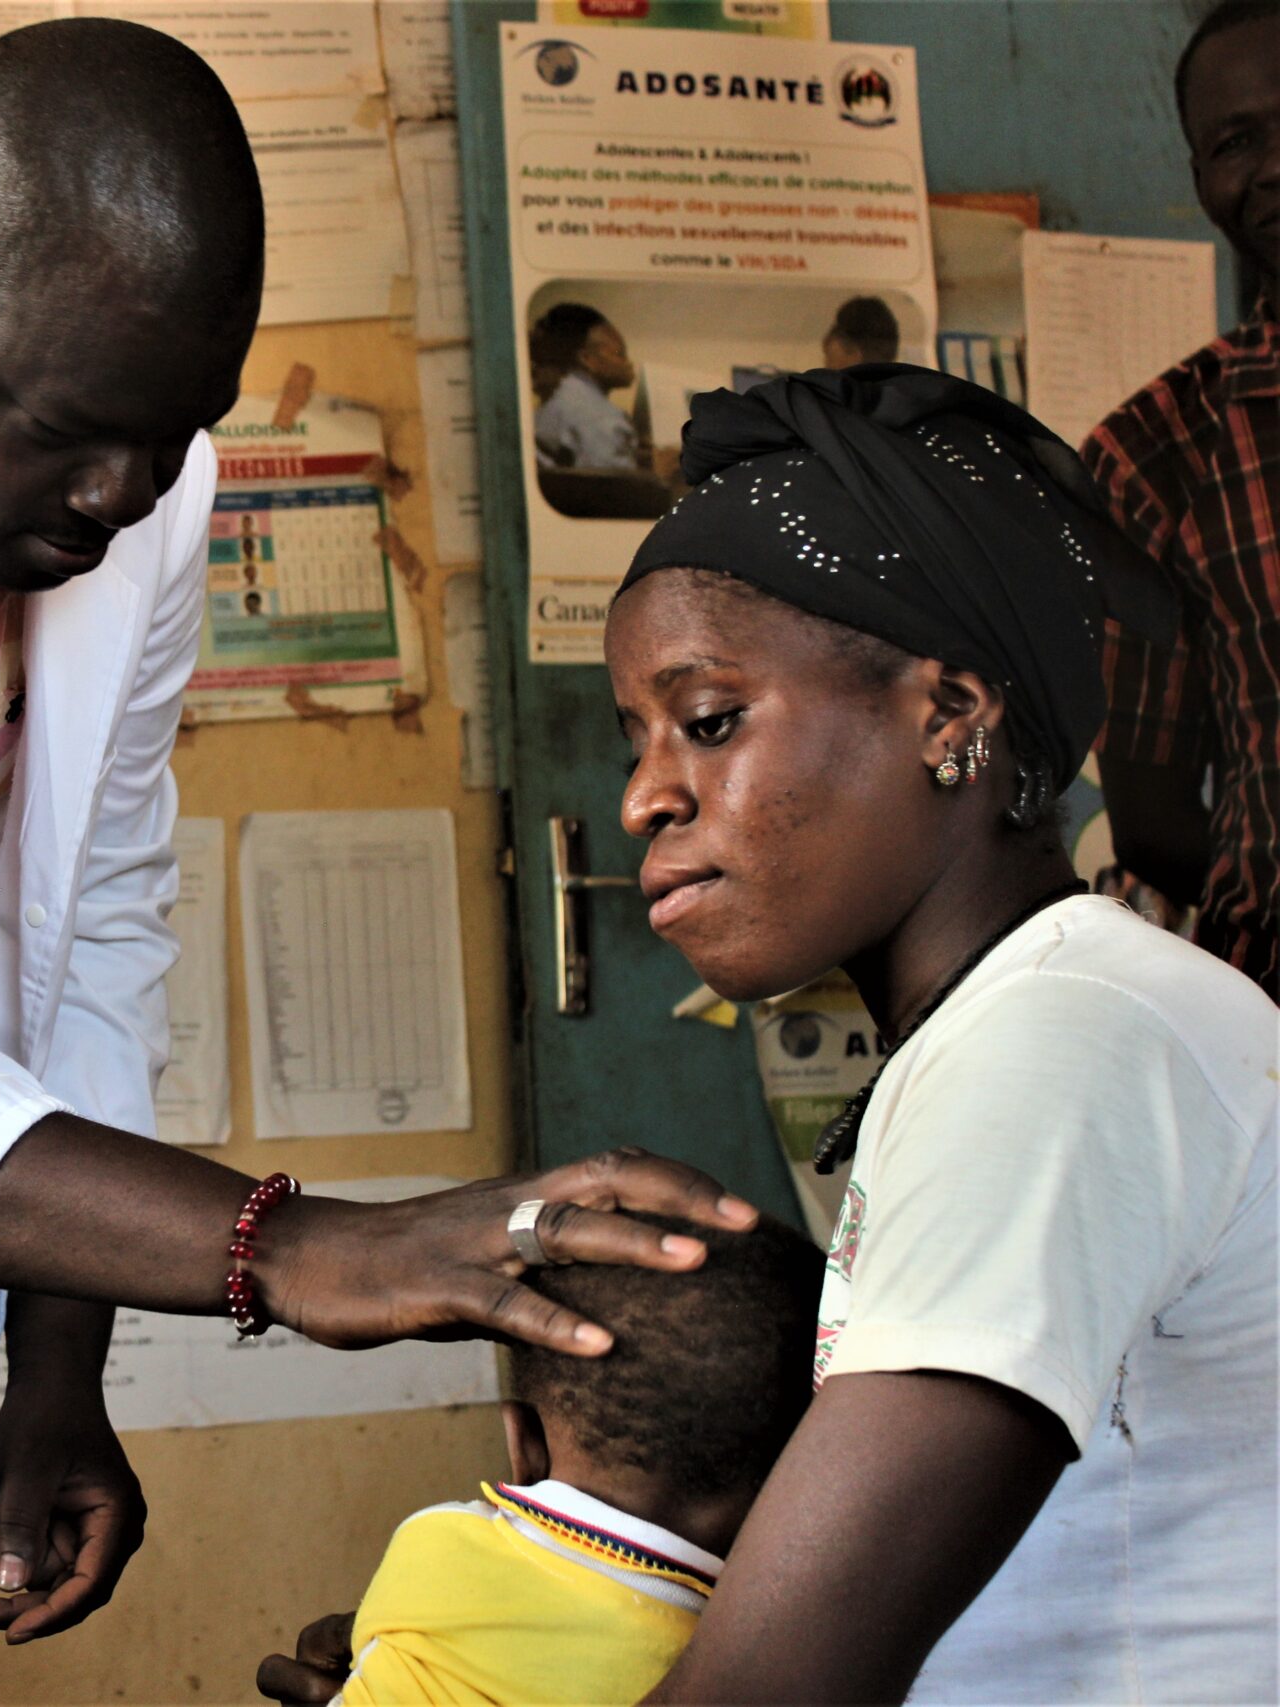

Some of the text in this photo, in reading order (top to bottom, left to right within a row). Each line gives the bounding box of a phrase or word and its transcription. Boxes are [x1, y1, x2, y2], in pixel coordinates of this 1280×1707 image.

[616, 71, 823, 105] ADOSANTÉ
[592, 166, 622, 182] des
[625, 168, 703, 186] méthodes
[783, 175, 804, 189] de
[808, 177, 916, 197] contraception
[521, 194, 561, 209] pour
[565, 195, 604, 208] vous
[683, 199, 715, 214] des
[806, 204, 839, 217] non
[536, 219, 554, 234] et
[557, 220, 590, 235] des
[593, 220, 675, 239] infections
[648, 252, 713, 267] comme
[717, 253, 733, 268] le
